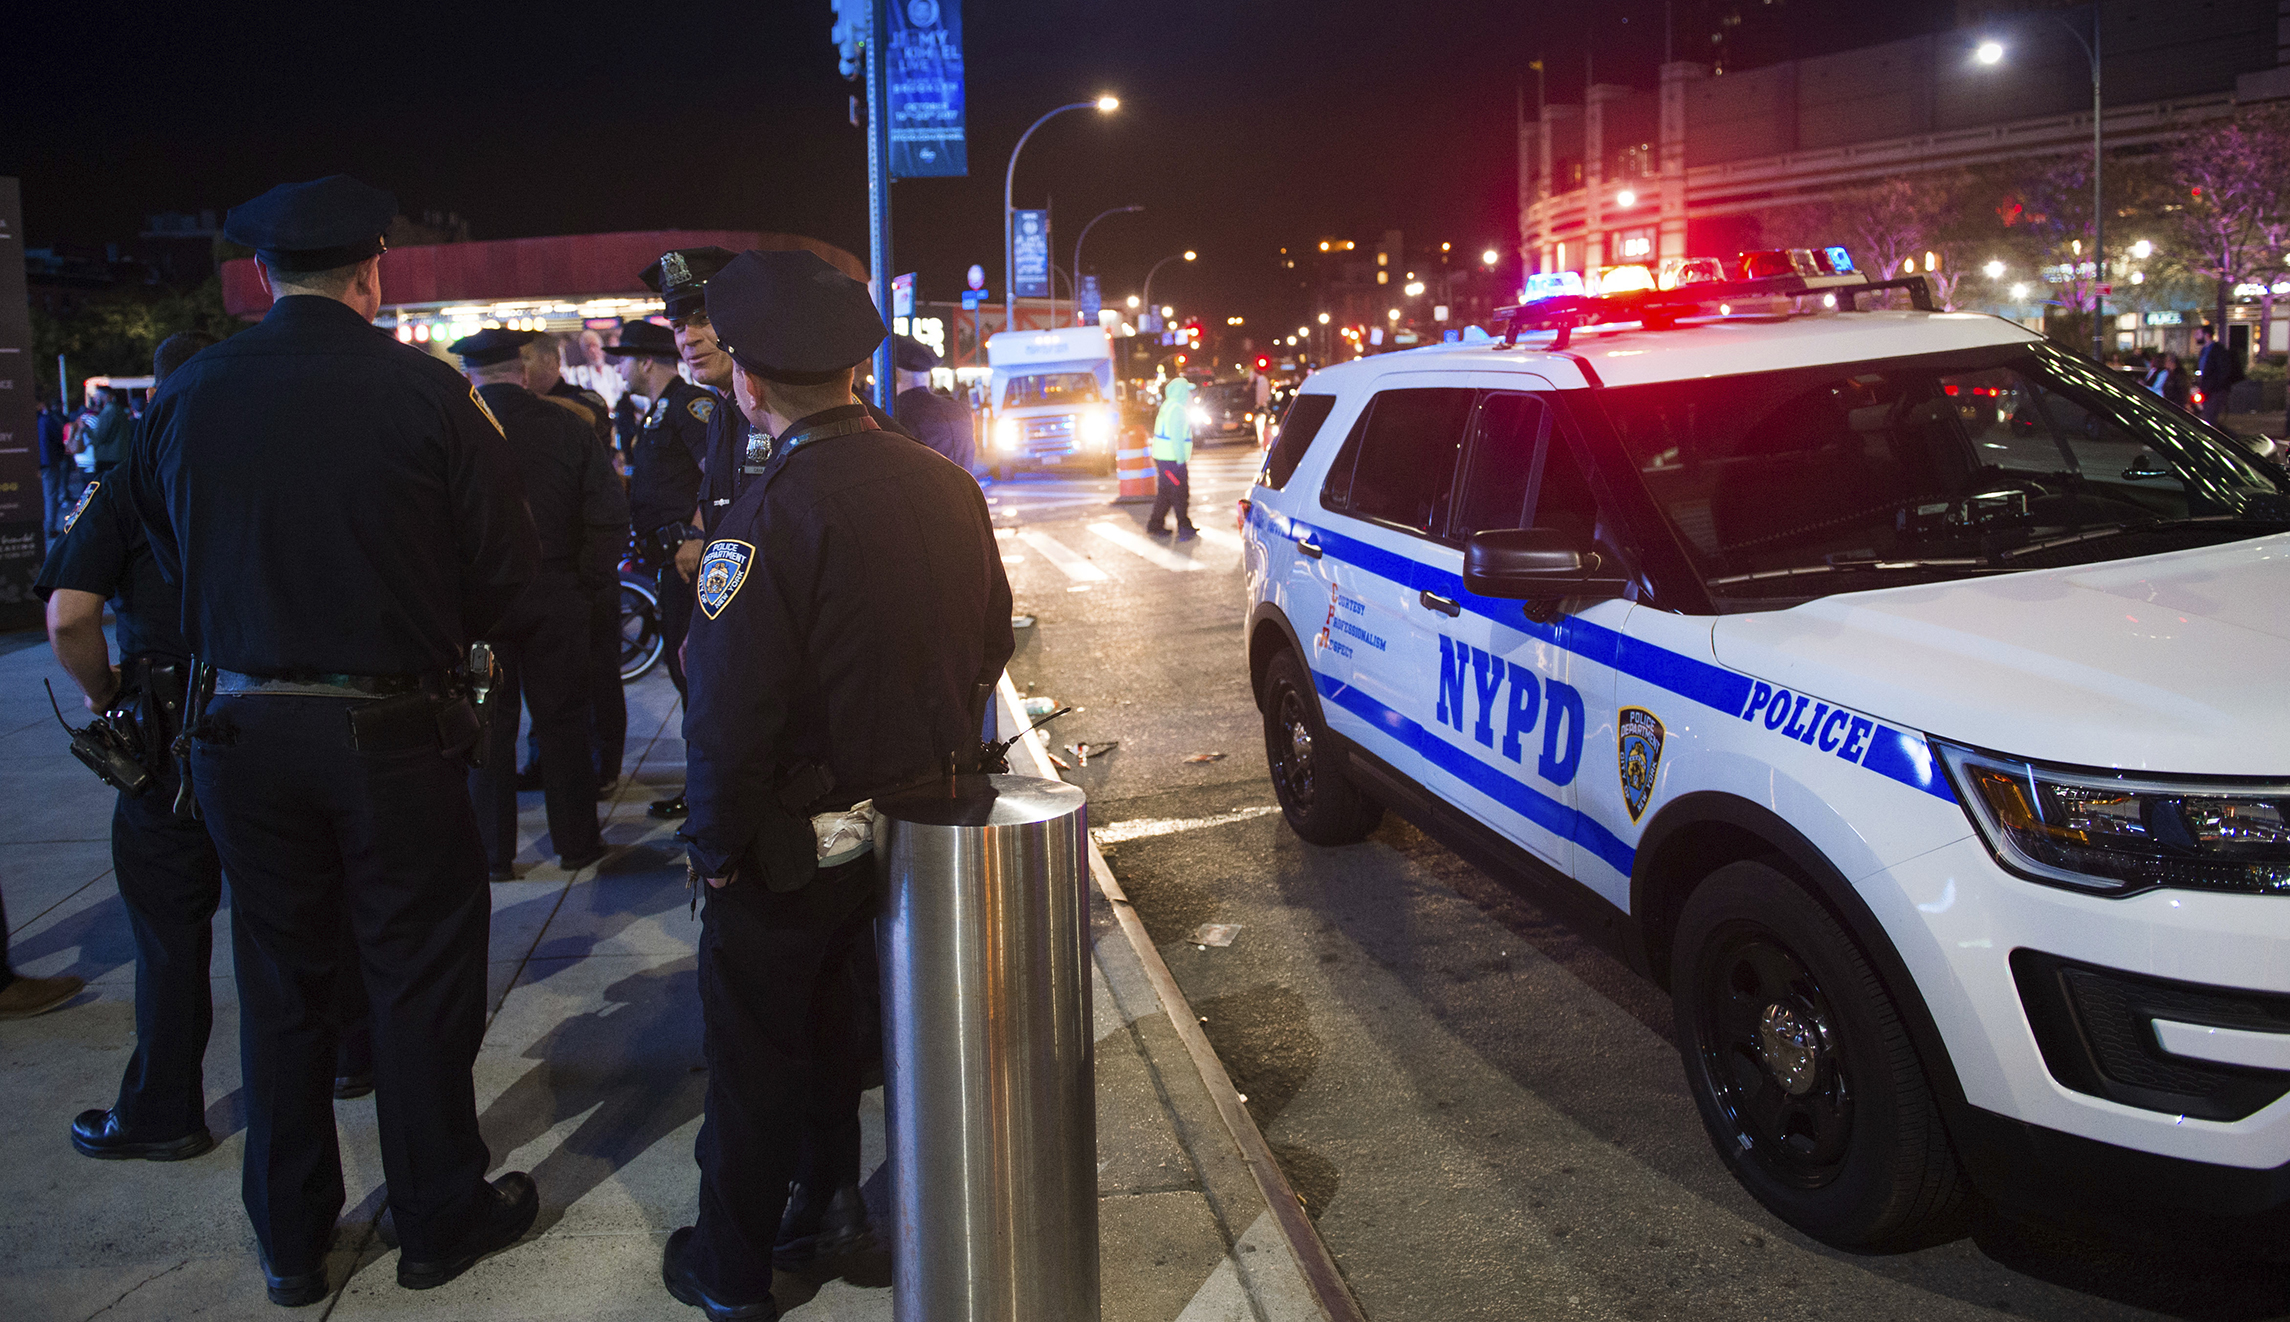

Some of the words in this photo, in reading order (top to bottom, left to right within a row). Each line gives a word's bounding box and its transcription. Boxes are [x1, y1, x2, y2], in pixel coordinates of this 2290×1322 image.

[703, 551, 746, 564] DEPARTMENT
[713, 543, 738, 551] POLICE
[714, 593, 728, 608] NEW
[728, 570, 744, 591] YORK
[1331, 582, 1366, 616] COURTESY
[1326, 604, 1387, 652] PROFESSIONALISM
[1436, 633, 1586, 788] NYPD
[1630, 711, 1655, 732] POLICE
[1742, 680, 1874, 765] POLICE
[1620, 723, 1661, 754] DEPARTMENT
[1637, 791, 1647, 812] NEW
[1647, 762, 1657, 789] YORK
